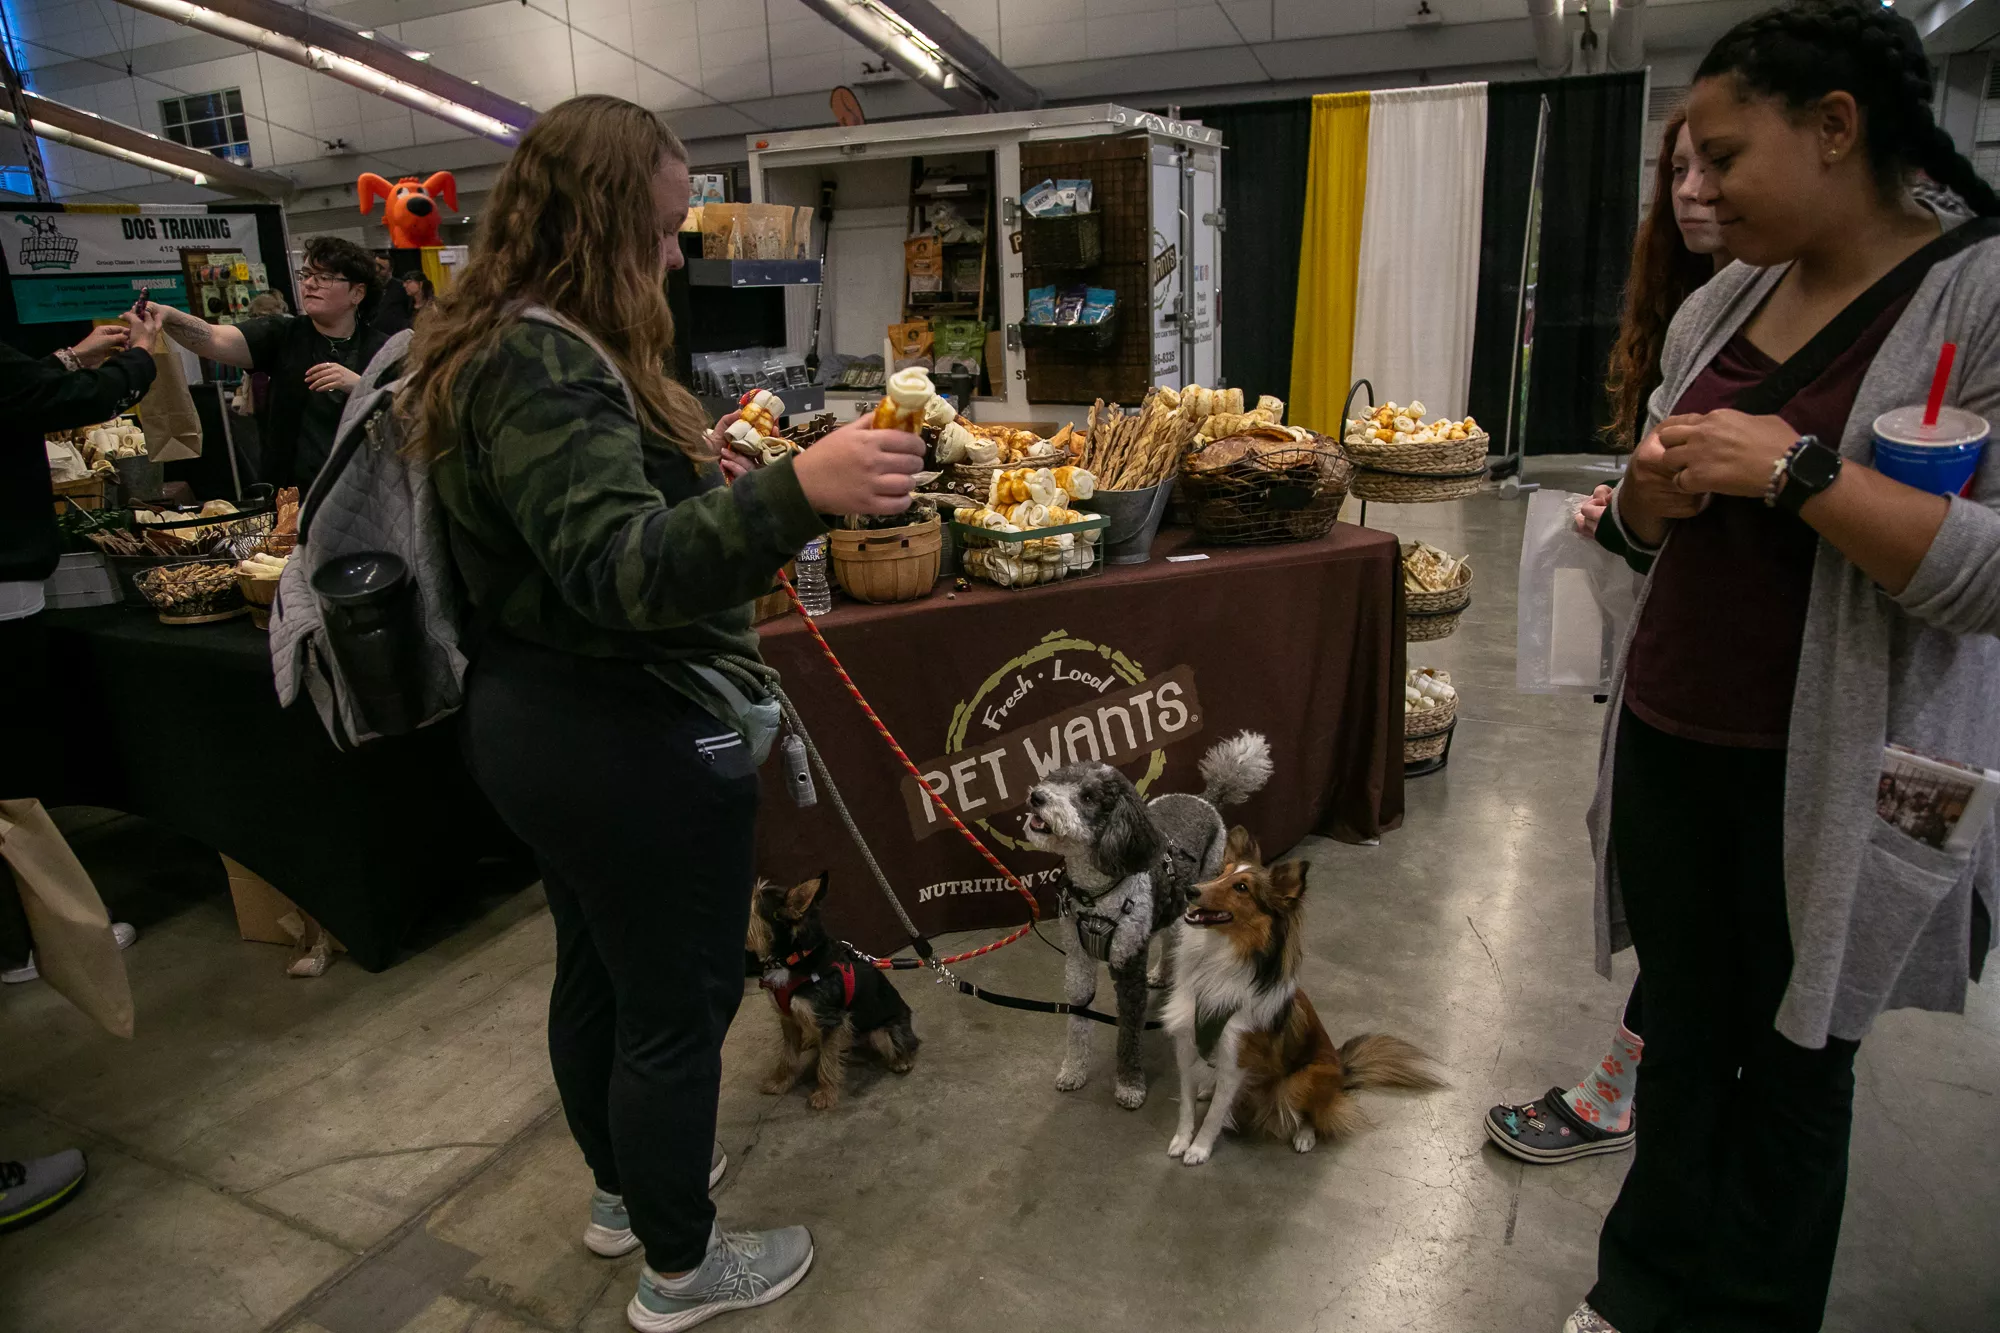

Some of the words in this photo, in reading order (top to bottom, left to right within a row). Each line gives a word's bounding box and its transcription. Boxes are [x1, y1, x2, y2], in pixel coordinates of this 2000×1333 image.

[121, 217, 158, 240] DOG
[159, 217, 232, 240] TRAINING
[22, 237, 78, 252] MISSION
[20, 249, 79, 265] PAWSIBLE
[1156, 248, 1175, 281] ANTS
[801, 547, 820, 555] DEER
[801, 554, 821, 562] PARK
[981, 673, 1034, 731] Fresh
[1052, 659, 1116, 694] Local
[917, 747, 1009, 824] PET
[1022, 680, 1191, 783] WANTS
[917, 873, 1035, 904] NUTRITION
[1036, 865, 1066, 887] YO
